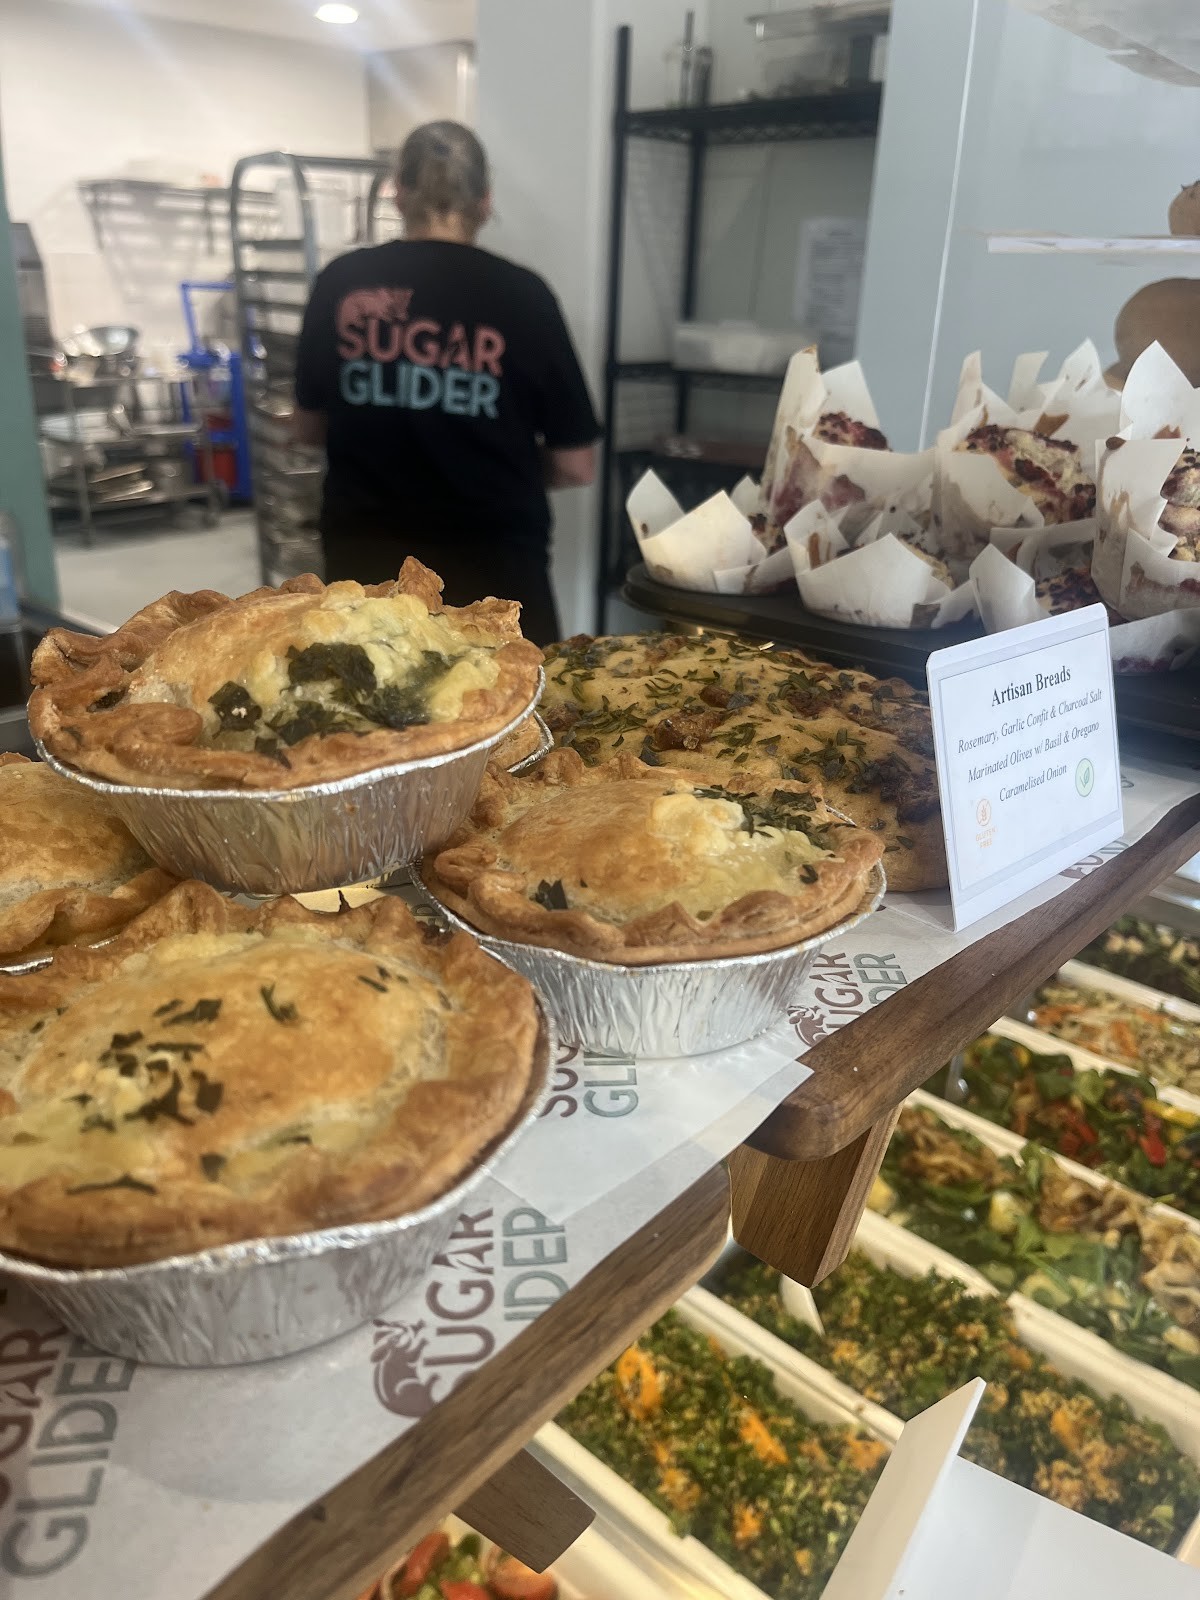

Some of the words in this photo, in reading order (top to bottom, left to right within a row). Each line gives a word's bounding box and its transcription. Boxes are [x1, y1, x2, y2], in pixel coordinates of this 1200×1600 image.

[337, 317, 506, 377] SUGAR
[341, 359, 500, 419] GLIDER
[992, 681, 1033, 707] Artisan
[1035, 665, 1071, 691] Breads
[958, 730, 999, 753] Rosemary,
[1001, 718, 1025, 737] Garlic
[1027, 709, 1049, 728] Confit
[1050, 705, 1057, 718] &
[1058, 694, 1088, 715] Charcoal
[1089, 688, 1102, 703] Salt
[968, 754, 1008, 783] Marinated
[1009, 748, 1033, 765] Olives
[1034, 741, 1043, 755] w/
[1044, 733, 1062, 752] Basil
[1063, 730, 1070, 744] &
[1071, 721, 1100, 740] Oregano
[1000, 770, 1045, 802] Caramelised
[1046, 764, 1067, 781] Onion
[0, 1336, 138, 1580] GLIDE
